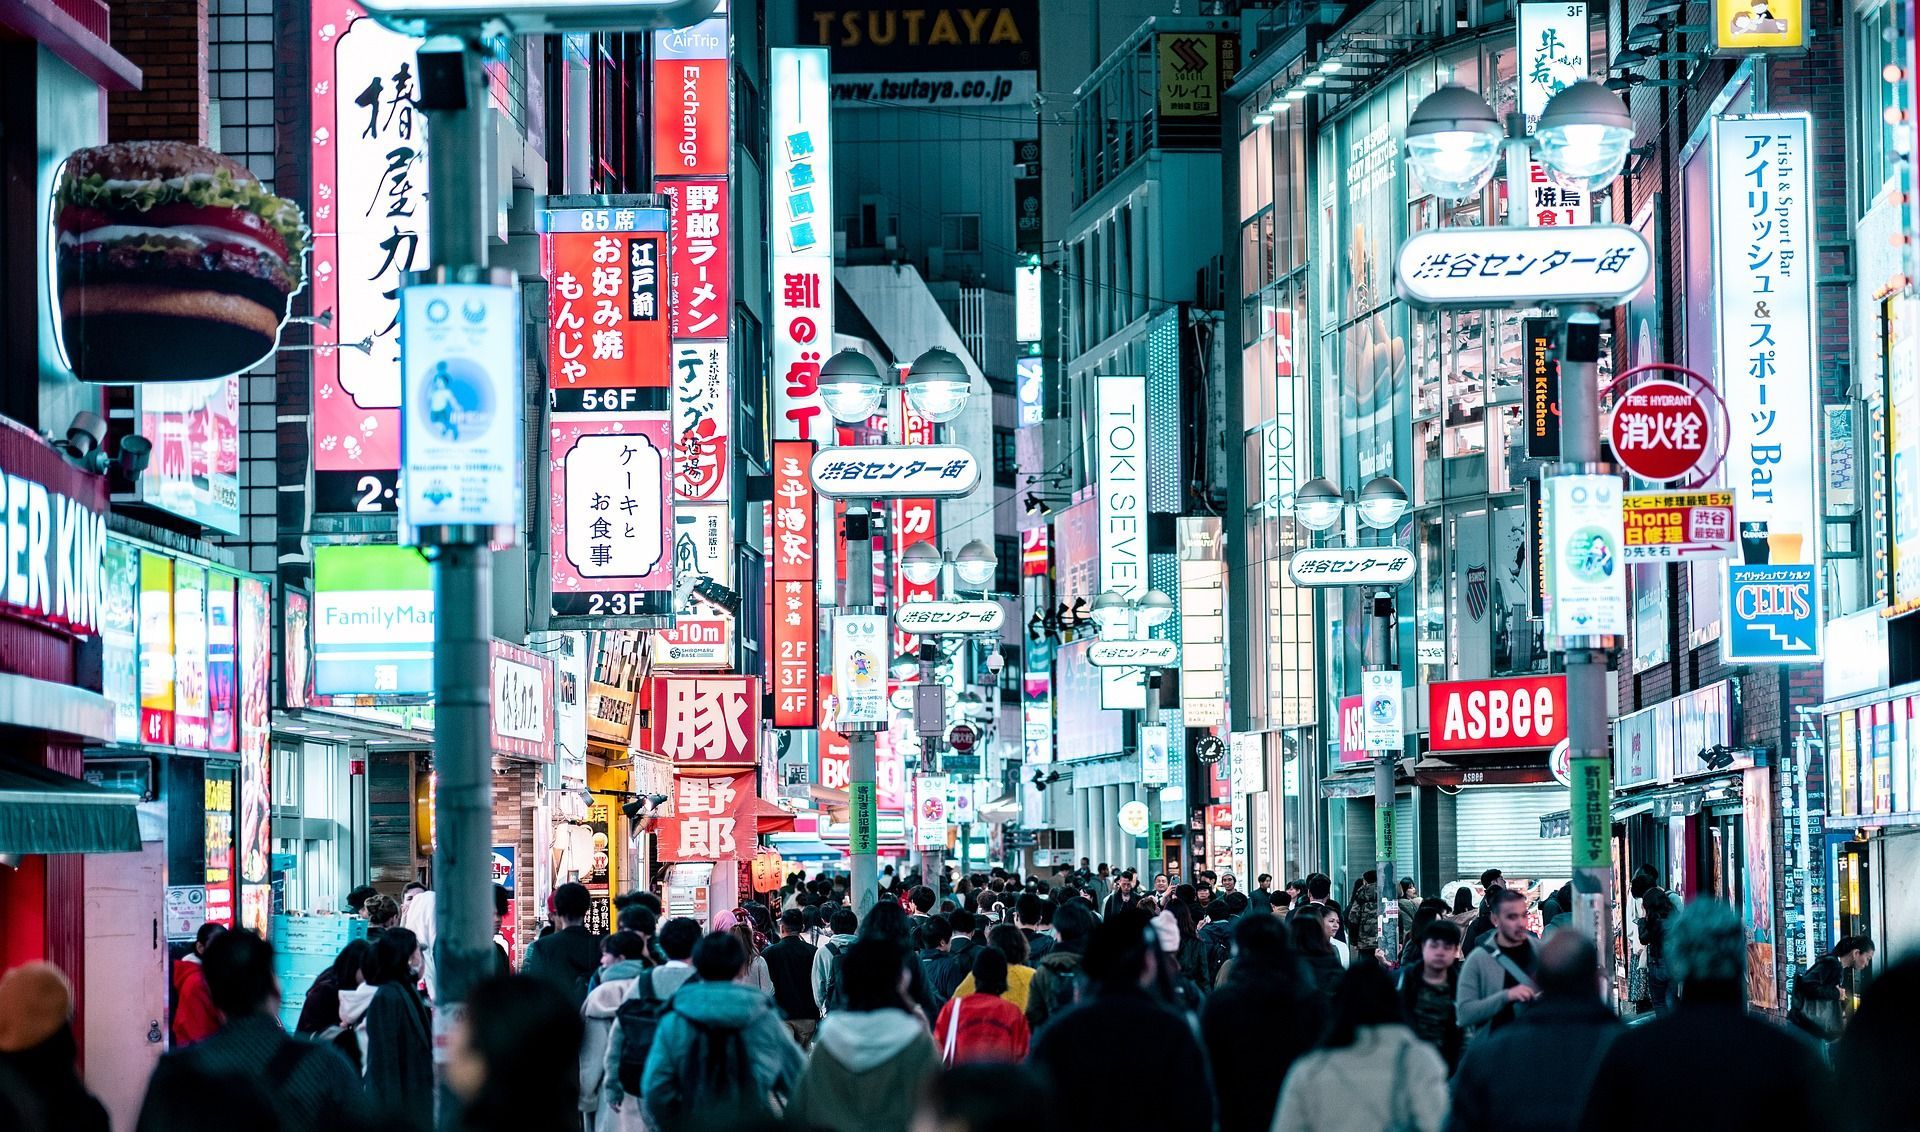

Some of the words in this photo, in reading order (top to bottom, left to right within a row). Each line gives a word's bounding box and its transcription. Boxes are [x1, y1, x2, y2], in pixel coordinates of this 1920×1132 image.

[813, 8, 1023, 46] TSUTAYA
[1567, 6, 1584, 17] 3F
[672, 34, 720, 49] AirTrip
[1167, 85, 1212, 98] ソレイユ
[679, 66, 700, 167] Exchange
[1778, 135, 1793, 177] Irish
[1779, 182, 1790, 192] &
[1775, 197, 1793, 246] Sport
[686, 185, 720, 334] 野郎ラーメン
[1413, 247, 1635, 278] 渋谷センター街
[1779, 250, 1795, 278] Bar
[592, 235, 624, 360] お好み焼
[631, 243, 655, 317] 江戸前
[555, 271, 587, 384] もんじゃ
[1535, 338, 1547, 373] First
[678, 349, 714, 433] テング
[1535, 378, 1548, 437] Kitchen
[1627, 396, 1648, 406] FIRE
[1651, 396, 1692, 406] HYDRANT
[1109, 404, 1135, 481] TOKI
[1620, 413, 1702, 450] 消火栓
[819, 460, 968, 481] 渋谷センター街
[619, 444, 639, 539] ケーキと
[588, 491, 613, 567] お食事
[1695, 511, 1725, 525] 渋谷
[57, 493, 107, 637] KING
[1298, 557, 1408, 573] 渋谷センター街
[903, 611, 997, 623] 渋谷センター街
[1736, 584, 1810, 620] CELTS
[781, 641, 807, 658] 2F
[375, 665, 398, 691] 酒
[781, 669, 807, 686] 3F
[662, 679, 748, 760] 豚
[781, 696, 807, 713] 4F
[1443, 687, 1554, 741] ASBee
[1463, 772, 1484, 782] ASBee
[677, 776, 736, 860] 野郎
[857, 785, 871, 849] 客引きは犯罪です
